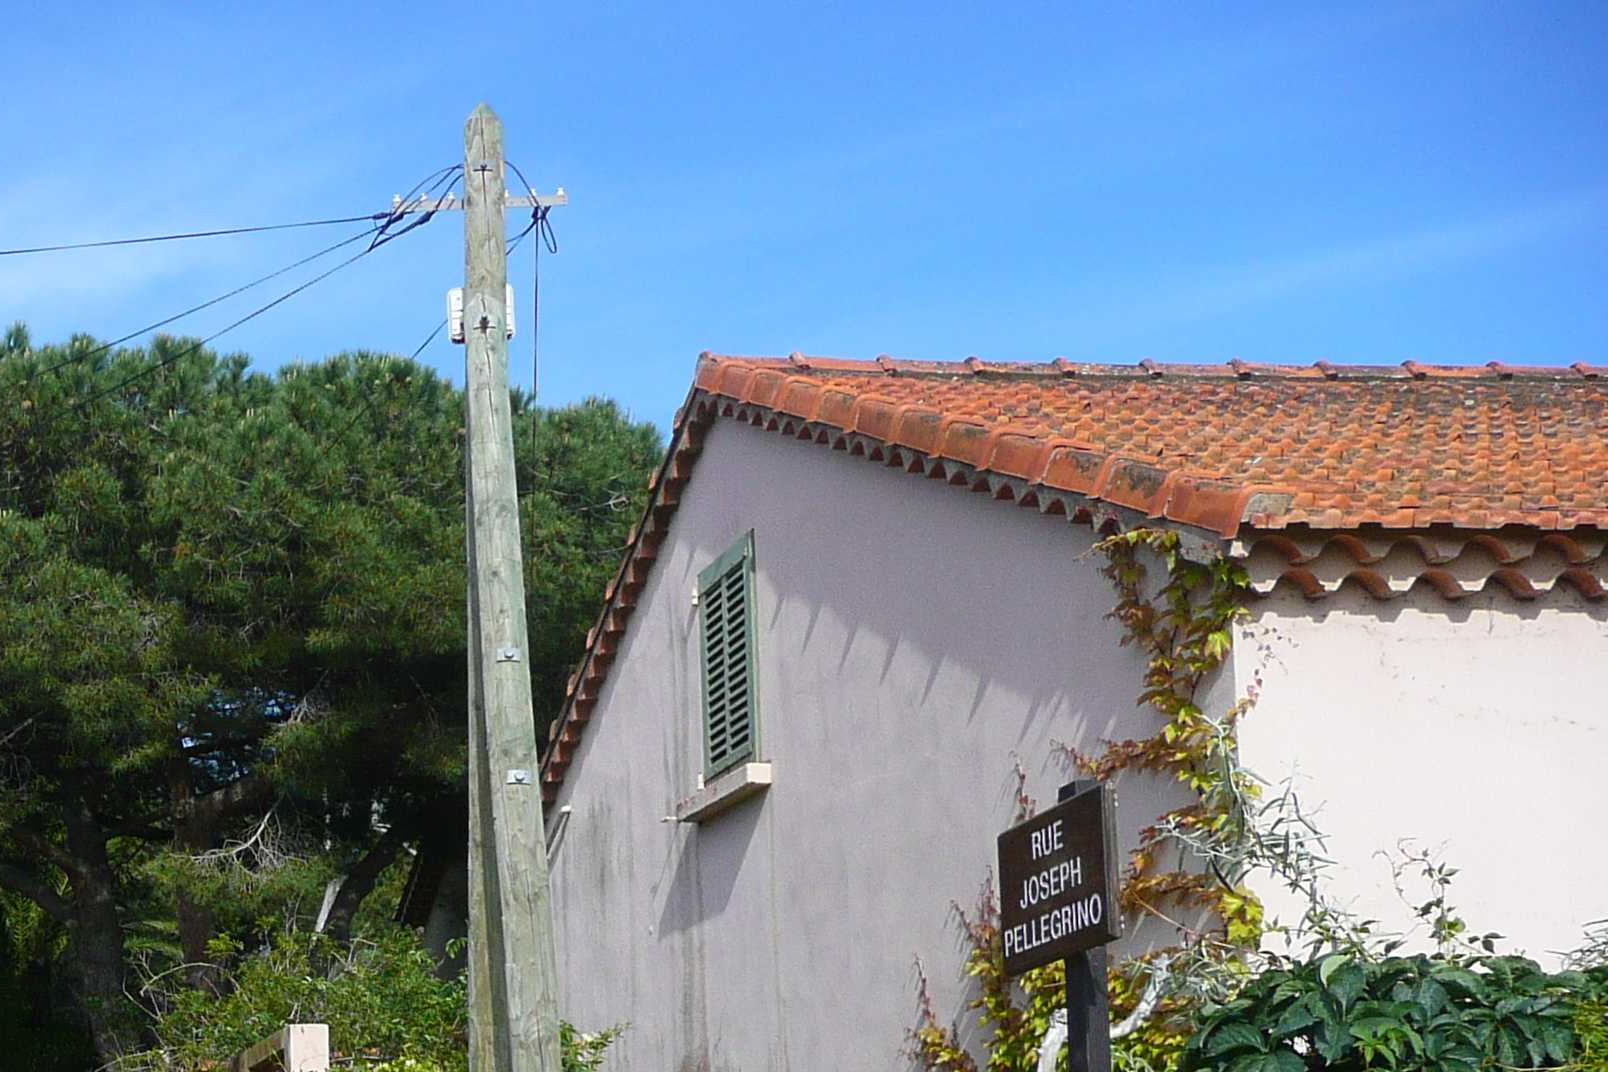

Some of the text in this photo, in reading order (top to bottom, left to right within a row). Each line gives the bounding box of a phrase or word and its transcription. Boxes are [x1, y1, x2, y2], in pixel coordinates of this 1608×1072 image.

[1031, 819, 1063, 860] RUE
[1020, 856, 1082, 909] JOSEPH
[1004, 894, 1102, 958] PELLEGRINO
